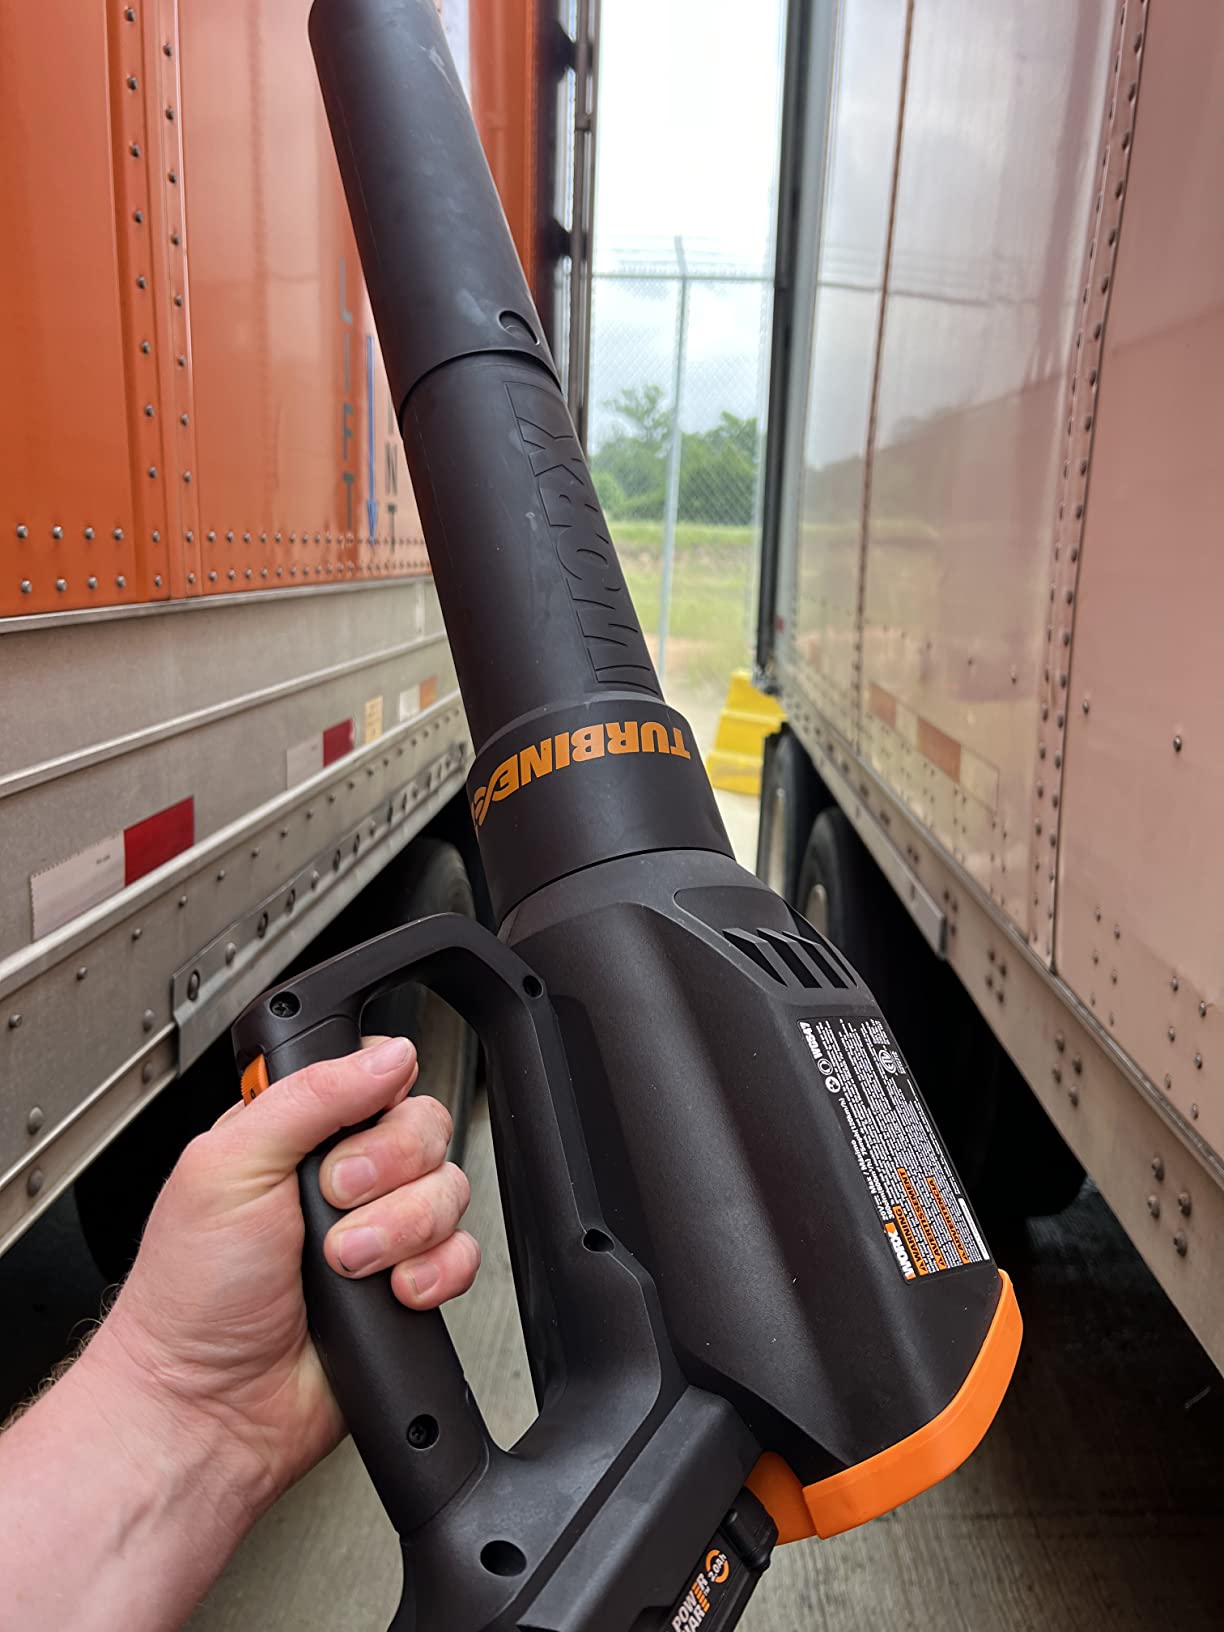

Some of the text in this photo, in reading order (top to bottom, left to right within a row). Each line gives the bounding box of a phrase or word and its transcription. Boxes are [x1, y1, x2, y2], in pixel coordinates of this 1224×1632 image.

[339, 256, 355, 531] LIFT
[514, 408, 653, 677] WORX
[477, 721, 691, 827] TURBINE
[799, 1021, 824, 1058] WG547
[894, 1207, 922, 1261] WARNING
[898, 1170, 941, 1256] AVERTISSEMENT
[927, 1179, 964, 1250] ADVERTENCIA
[887, 1230, 915, 1276] WORX
